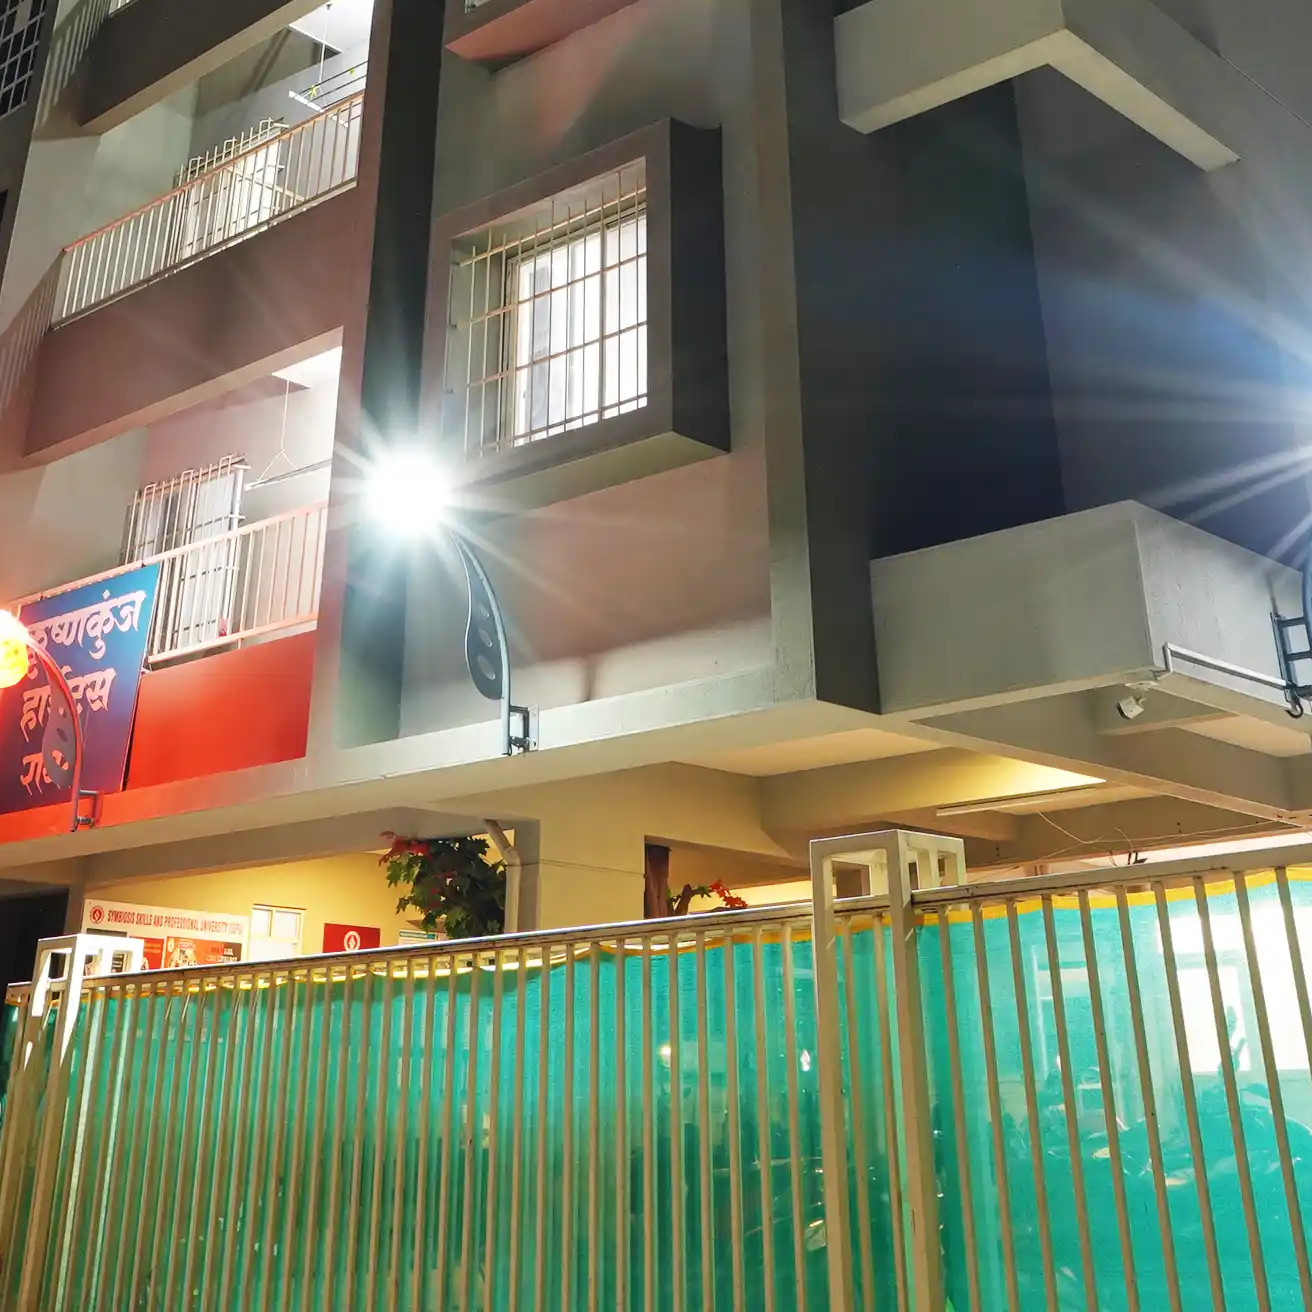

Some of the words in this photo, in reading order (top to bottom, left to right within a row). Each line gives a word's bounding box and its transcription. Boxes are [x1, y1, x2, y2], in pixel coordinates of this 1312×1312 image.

[108, 910, 135, 924] SYMBIOSIS
[136, 913, 152, 926] SKILLS
[154, 915, 164, 928] AND
[164, 916, 199, 930] PROFESSIONAL
